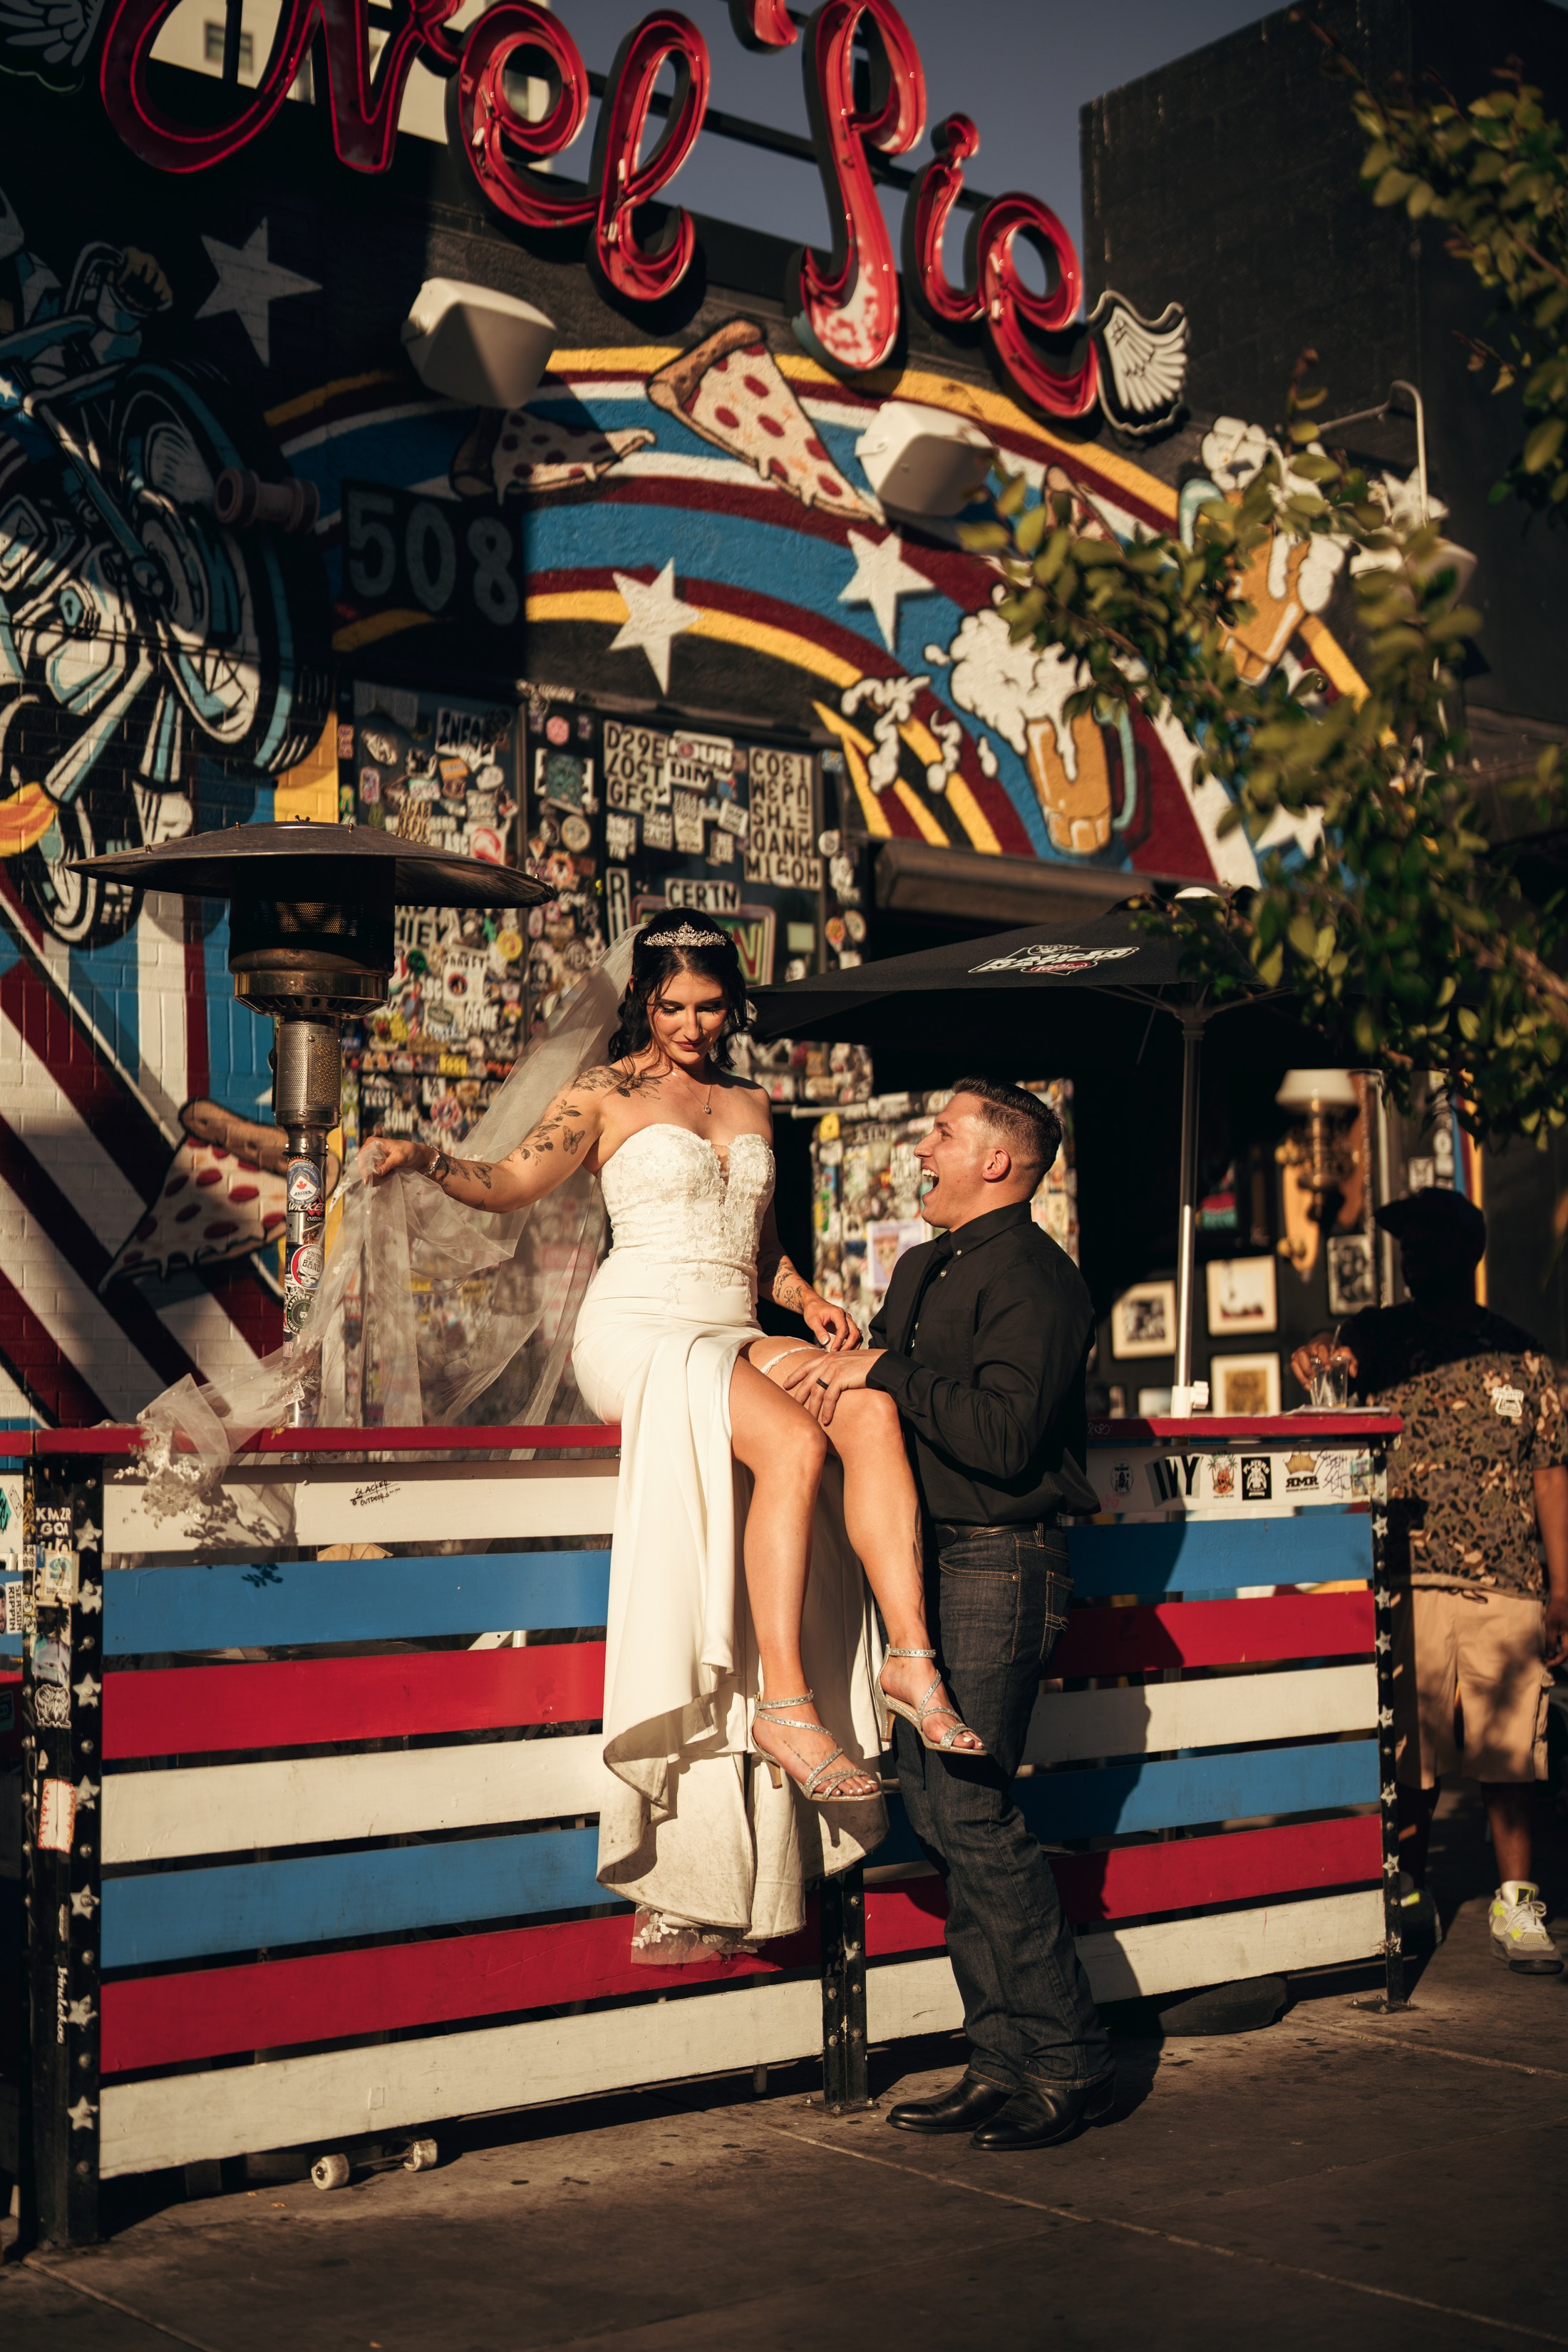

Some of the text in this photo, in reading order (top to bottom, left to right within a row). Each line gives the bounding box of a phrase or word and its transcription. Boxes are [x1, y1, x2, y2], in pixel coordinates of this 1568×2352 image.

[733, 0, 1099, 417] Pie
[348, 490, 519, 626] 508
[288, 1201, 326, 1212] WICKED
[302, 1259, 321, 1272] BAND
[287, 1294, 310, 1310] LANTERN
